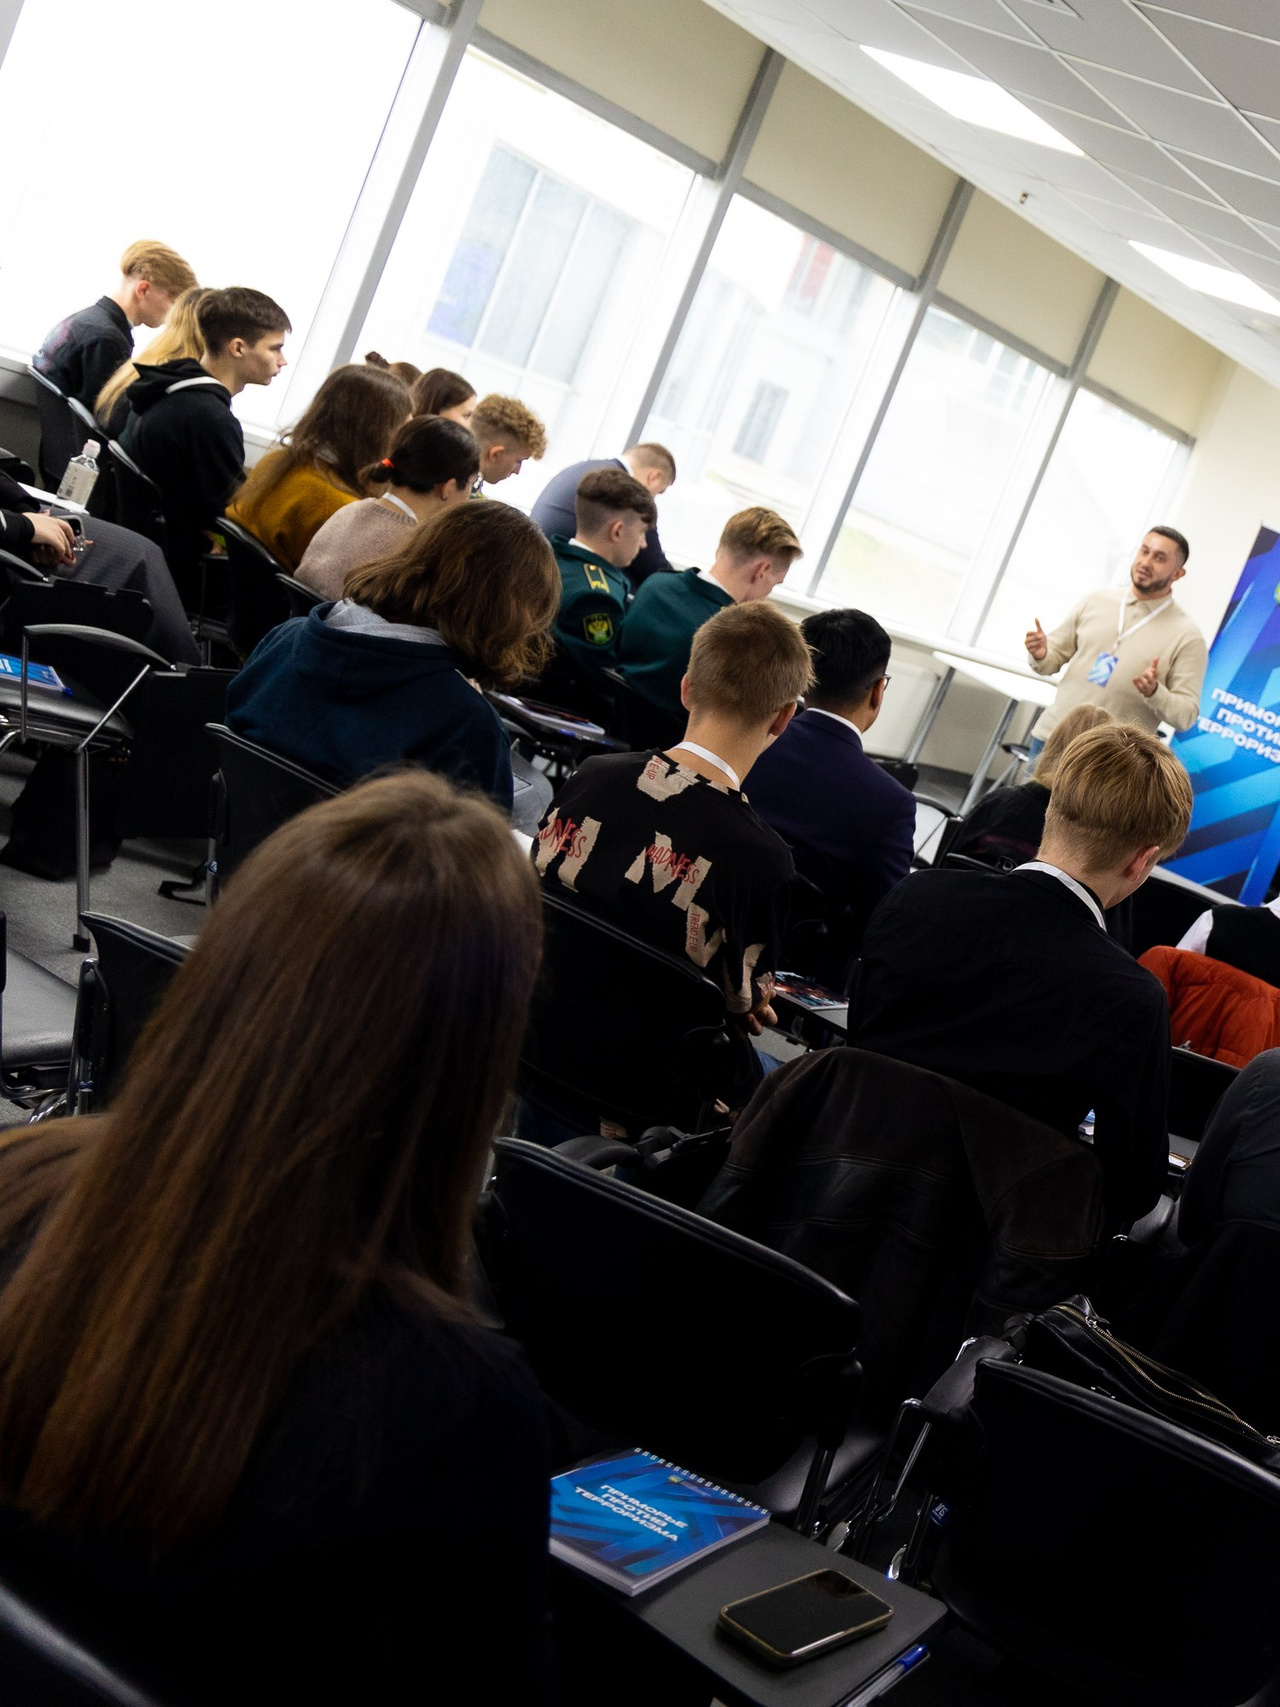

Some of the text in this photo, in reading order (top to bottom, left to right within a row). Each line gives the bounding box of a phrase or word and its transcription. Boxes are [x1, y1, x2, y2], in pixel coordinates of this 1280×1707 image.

[646, 843, 700, 884] MADNESS
[574, 1486, 679, 1542] ТЕРРОРИЗМА
[600, 1484, 689, 1529] ПРИМОРЬЕ
[601, 1492, 669, 1528] ПРОТИВ
